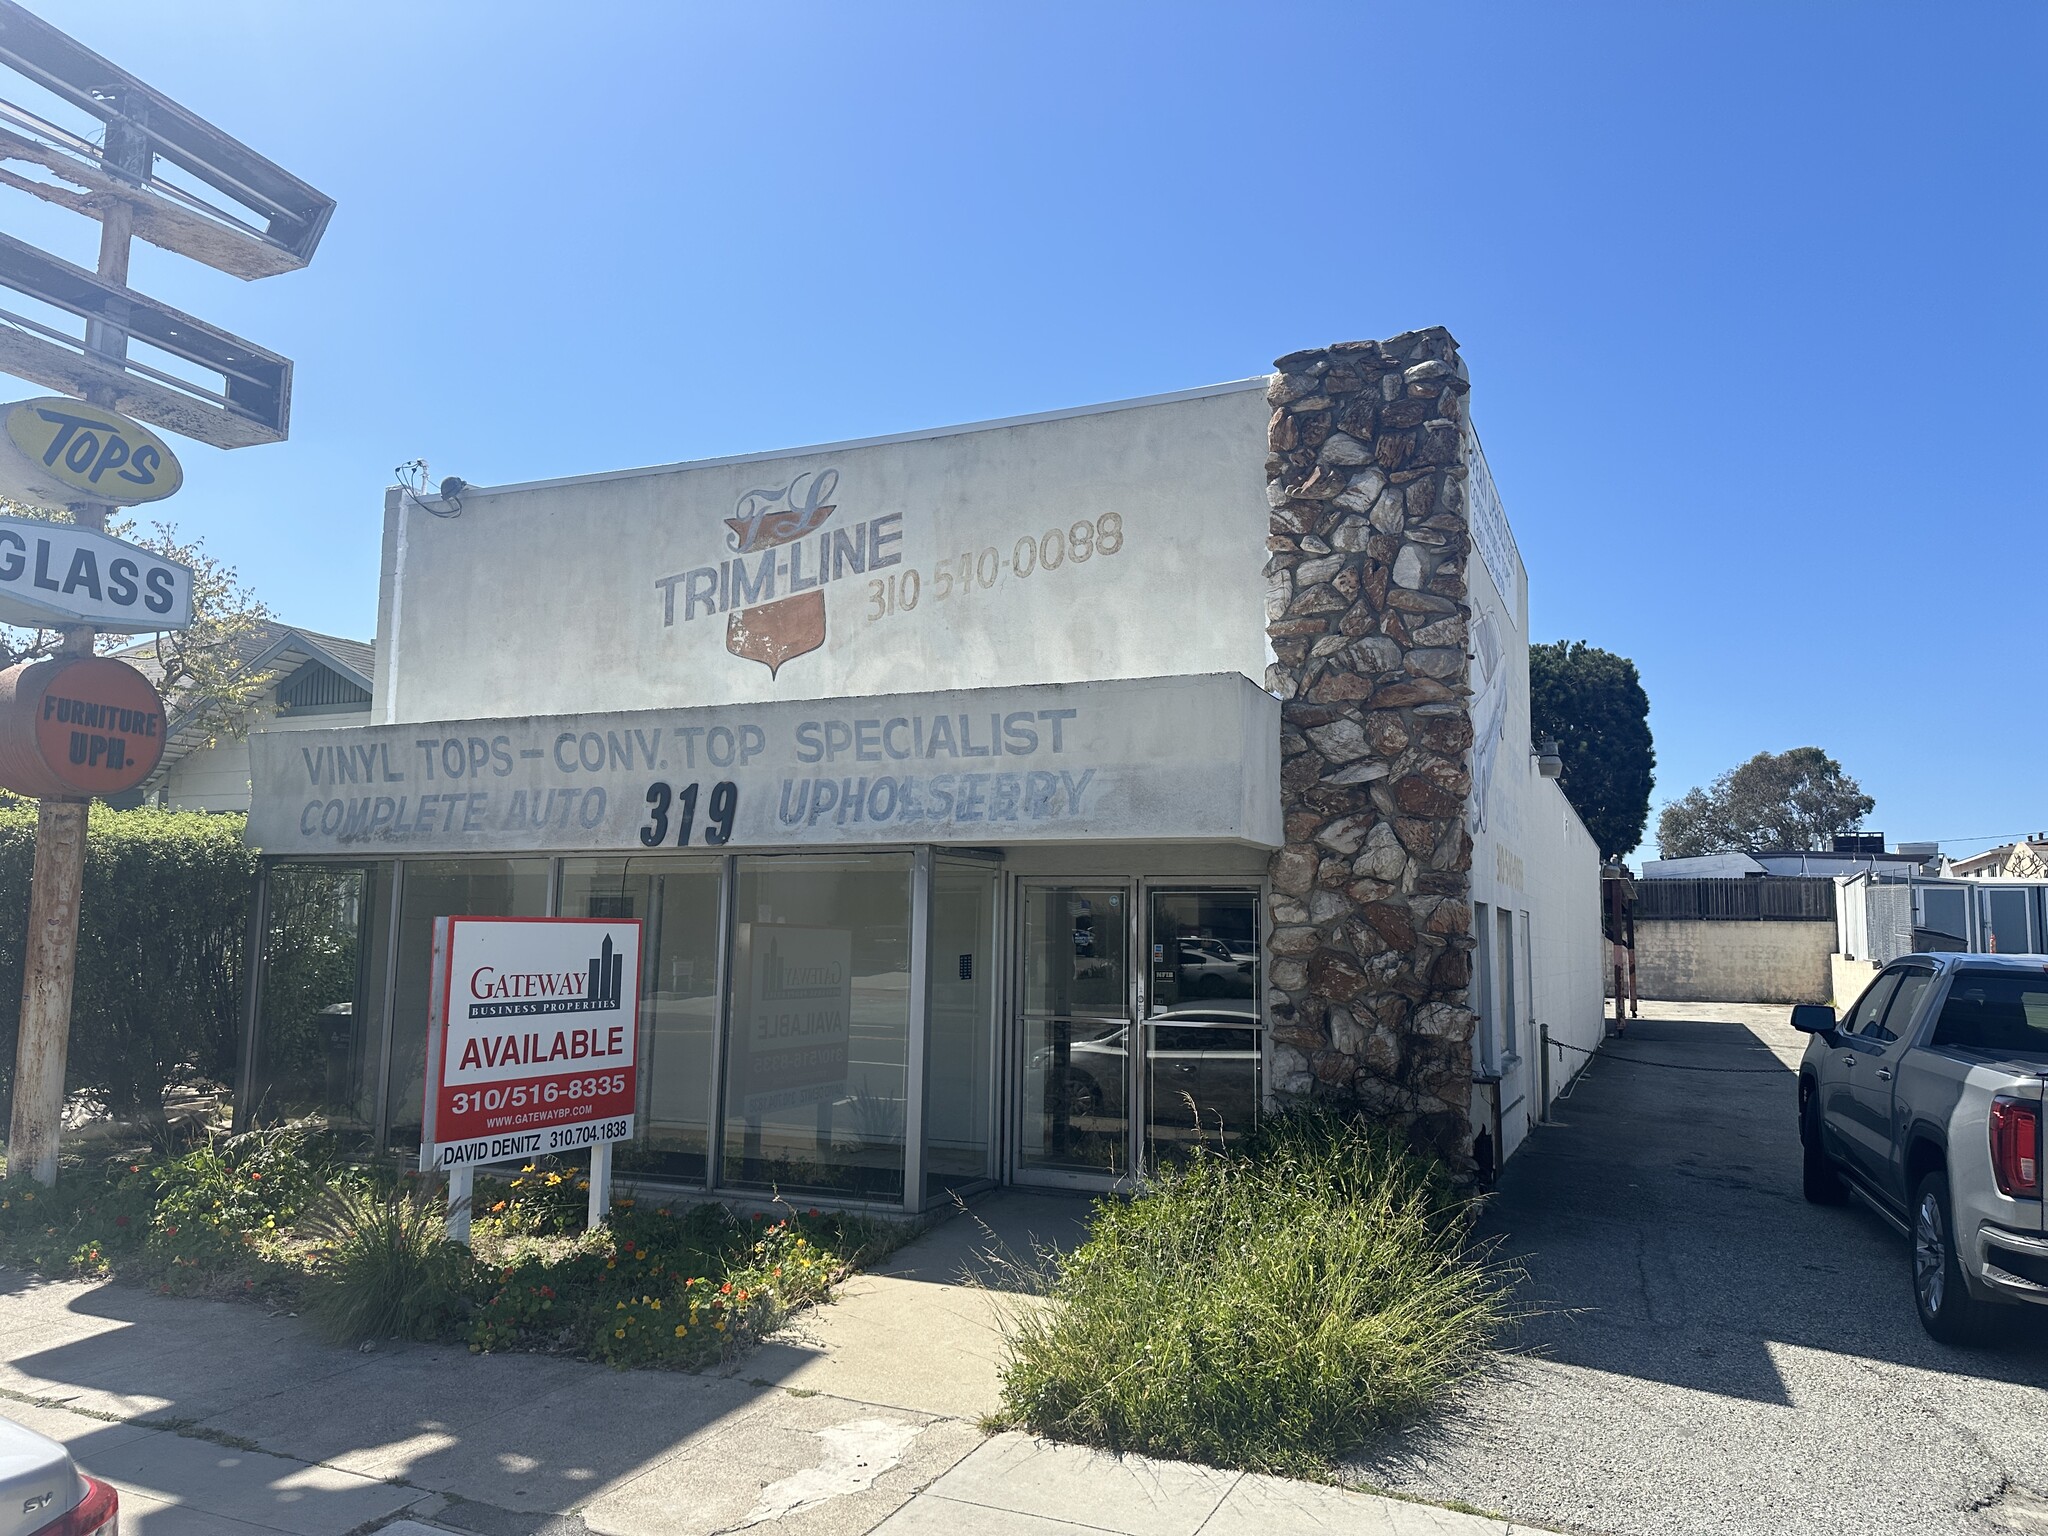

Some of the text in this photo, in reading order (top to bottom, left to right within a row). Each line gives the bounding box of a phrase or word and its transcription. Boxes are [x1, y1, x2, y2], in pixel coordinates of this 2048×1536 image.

[37, 408, 160, 486] TOPS
[0, 530, 175, 614] GLASS
[655, 512, 903, 627] TRIM-LINE
[43, 696, 159, 738] FURNITURE
[69, 732, 135, 770] UPH.
[302, 742, 404, 786] VINYL
[675, 724, 766, 770] TOP
[796, 708, 1077, 764] SPECIALIST
[301, 792, 488, 837] COMPLETE
[502, 786, 607, 832] AUTO
[640, 781, 738, 847] 319
[470, 966, 587, 1000] GATEWAY
[472, 999, 616, 1016] BUSINESS PROPERTIES
[459, 1026, 624, 1071] AVAILABLE
[451, 1074, 626, 1115] 310/516-8335
[486, 1104, 593, 1129] WWW.GATEWAYBP.COM
[443, 1120, 627, 1165] DAVID DENITZ 310.704.1838
[23, 1491, 54, 1514] SV
